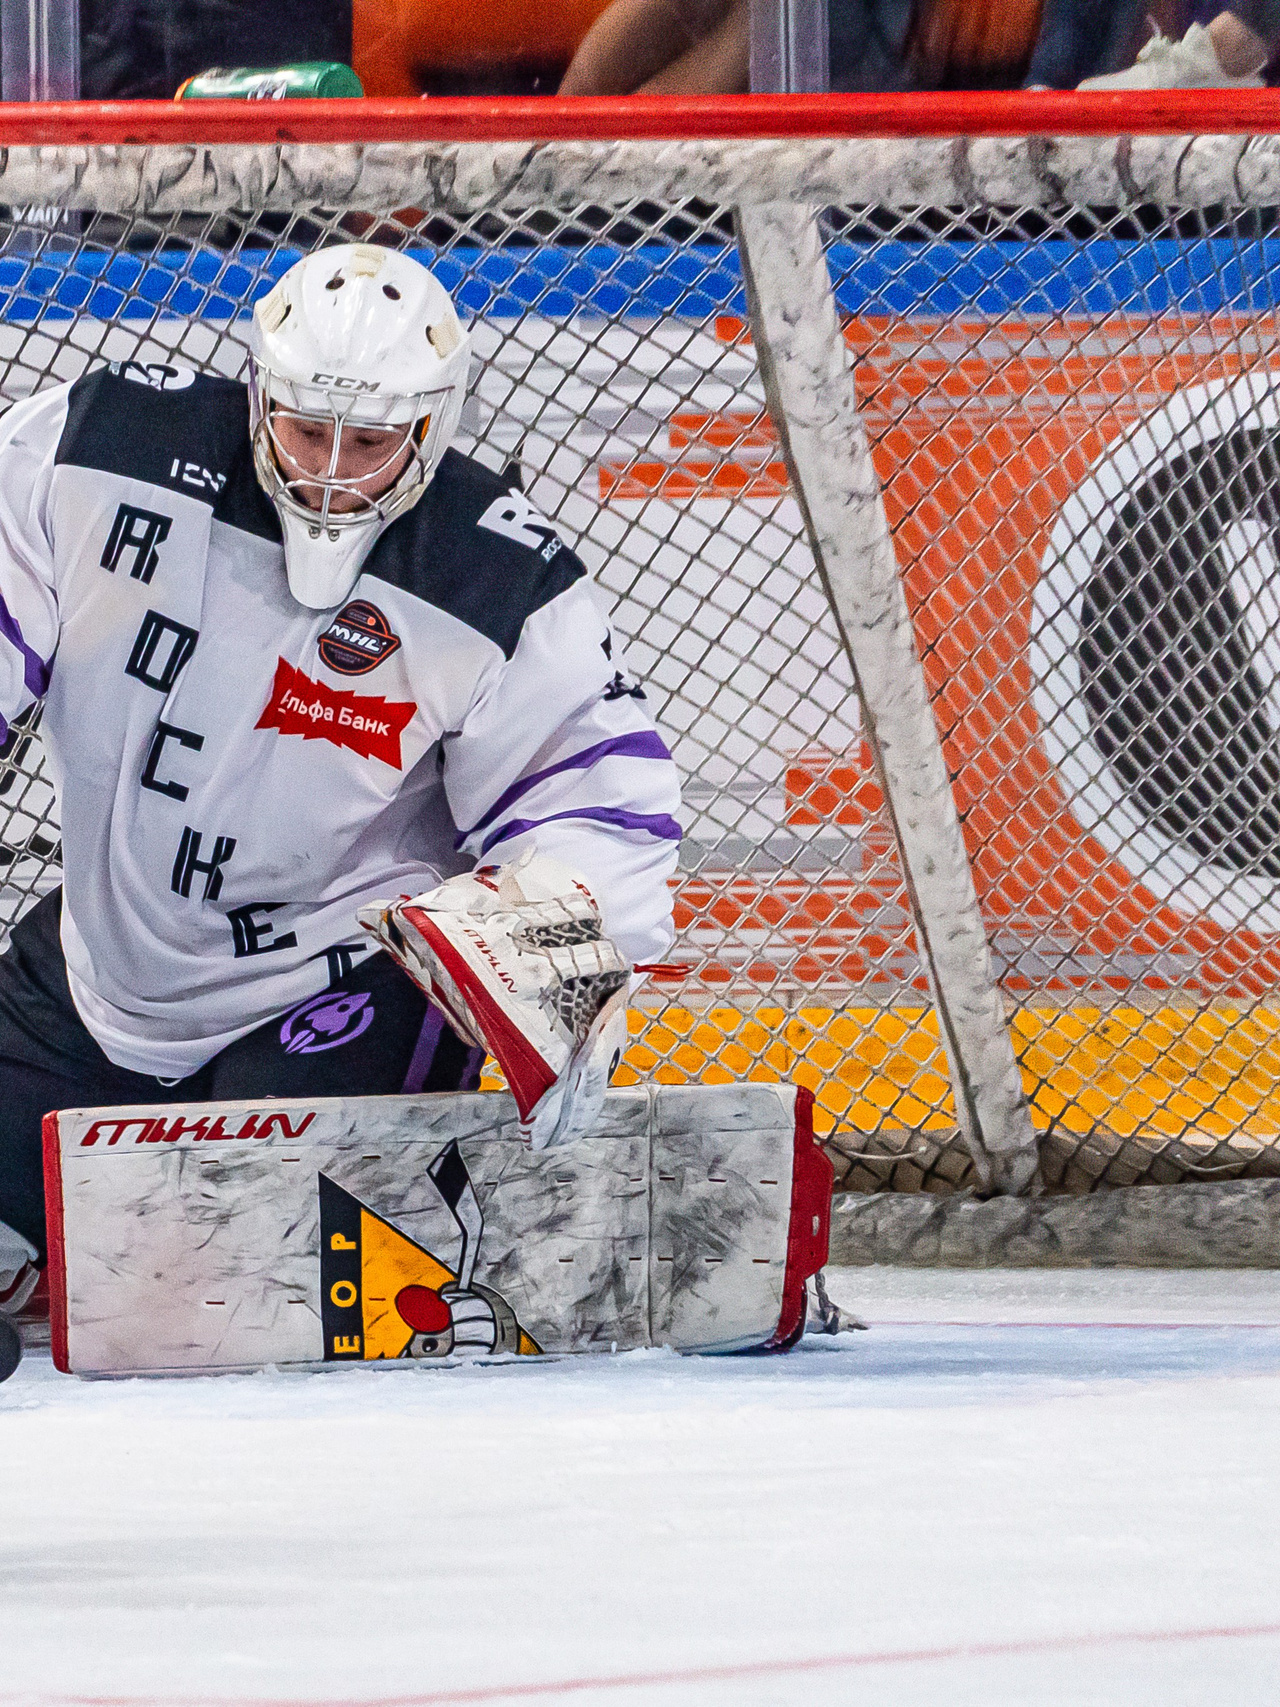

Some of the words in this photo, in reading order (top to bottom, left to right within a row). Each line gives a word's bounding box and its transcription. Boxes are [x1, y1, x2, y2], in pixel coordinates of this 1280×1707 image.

[311, 373, 381, 392] CCM
[338, 706, 391, 736] Банк
[80, 1111, 317, 1147] MIKLIN
